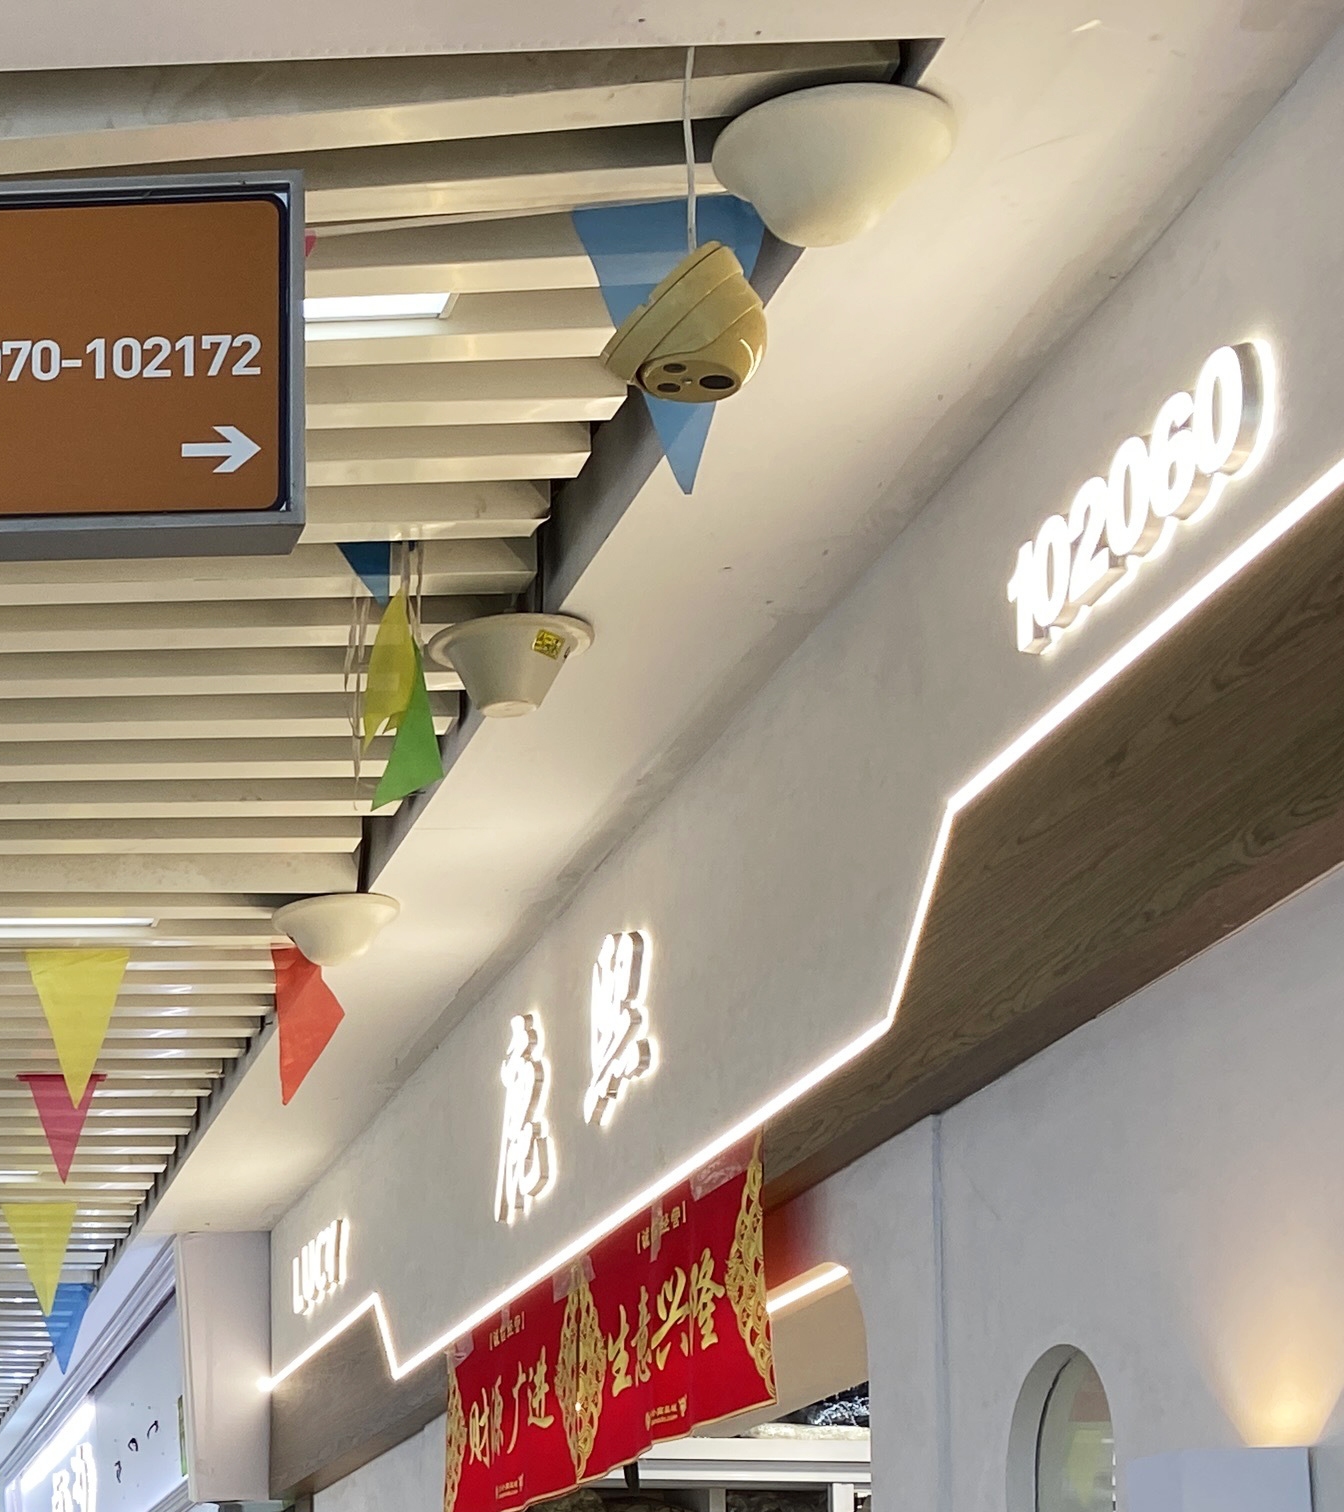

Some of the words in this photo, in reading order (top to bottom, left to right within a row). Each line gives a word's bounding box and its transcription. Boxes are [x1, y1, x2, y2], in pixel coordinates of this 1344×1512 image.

[1009, 338, 1272, 655] 102060
[608, 1247, 725, 1398] 生意兴隆
[468, 1345, 555, 1469] 财源广进
